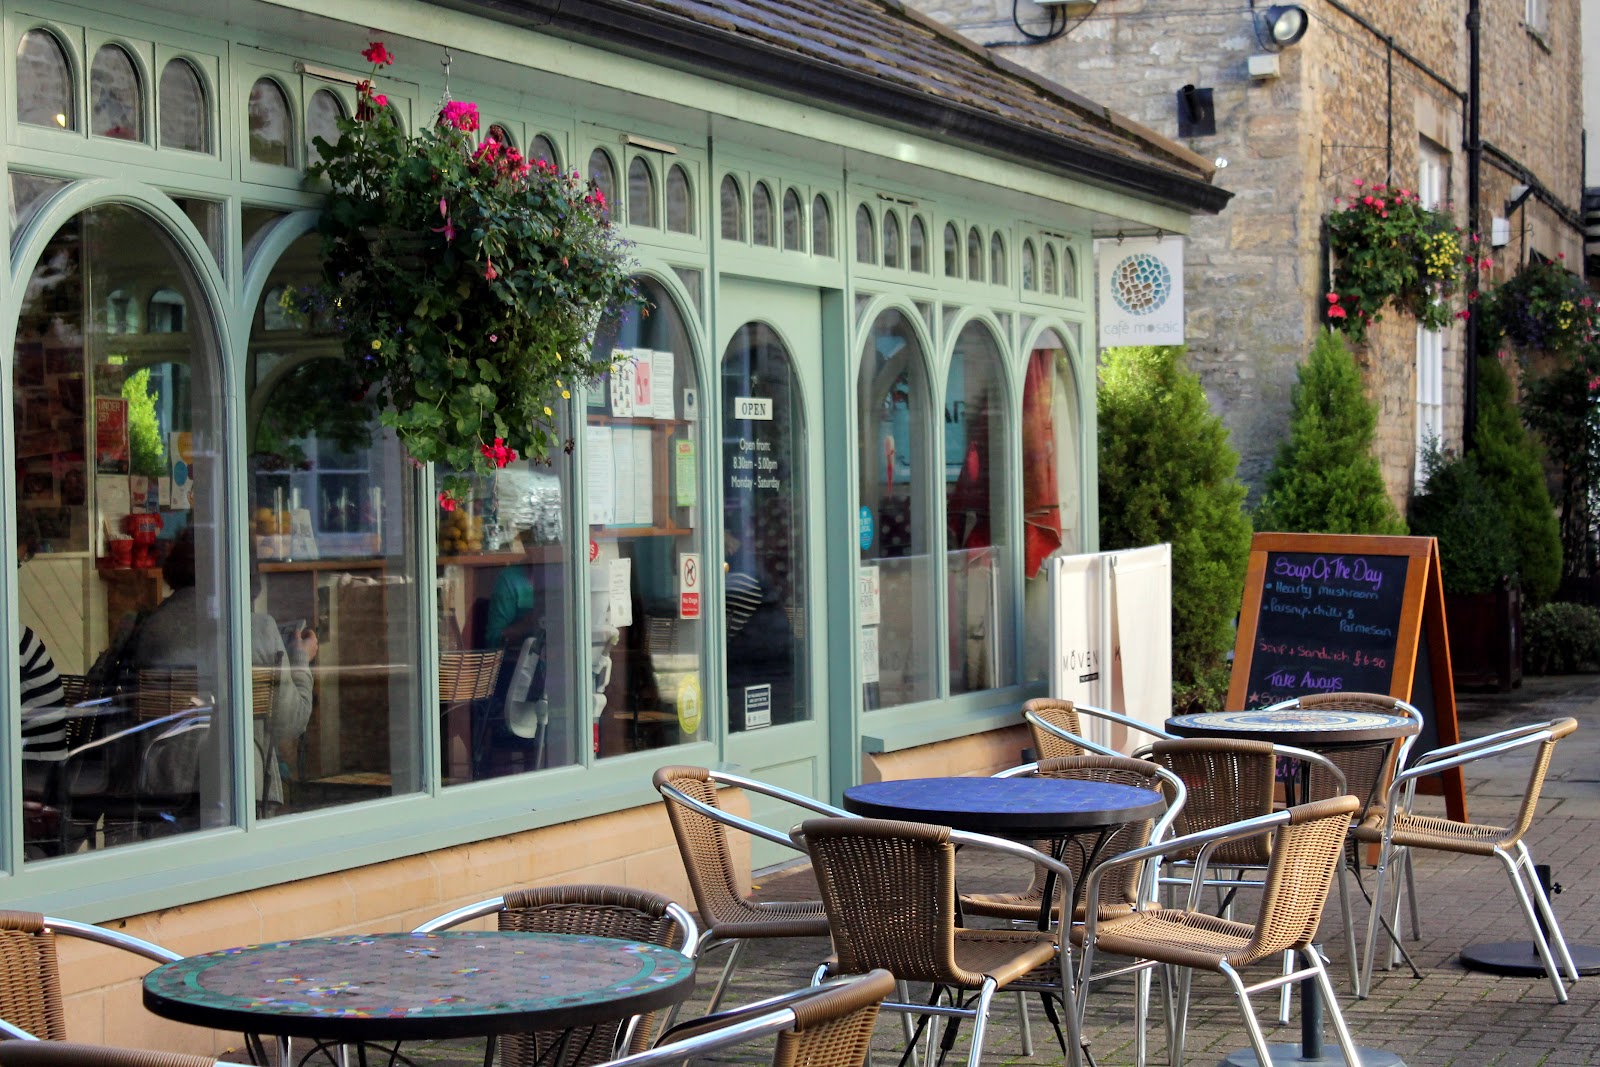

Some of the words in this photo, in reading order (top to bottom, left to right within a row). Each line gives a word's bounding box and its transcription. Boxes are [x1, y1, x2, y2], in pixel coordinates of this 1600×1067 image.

[1103, 321, 1130, 337] café
[1134, 320, 1181, 335] mosaic
[741, 402, 767, 416] OPEN
[740, 438, 755, 454] Open
[731, 475, 753, 492] Monday
[757, 476, 780, 492] Saturday
[1274, 557, 1311, 583] Soup
[1312, 557, 1331, 583] Of
[1330, 557, 1351, 579] The
[1353, 558, 1383, 591] Day
[1275, 581, 1312, 599] Hearty
[1264, 669, 1296, 689] Take
[1300, 671, 1343, 693] Aways
